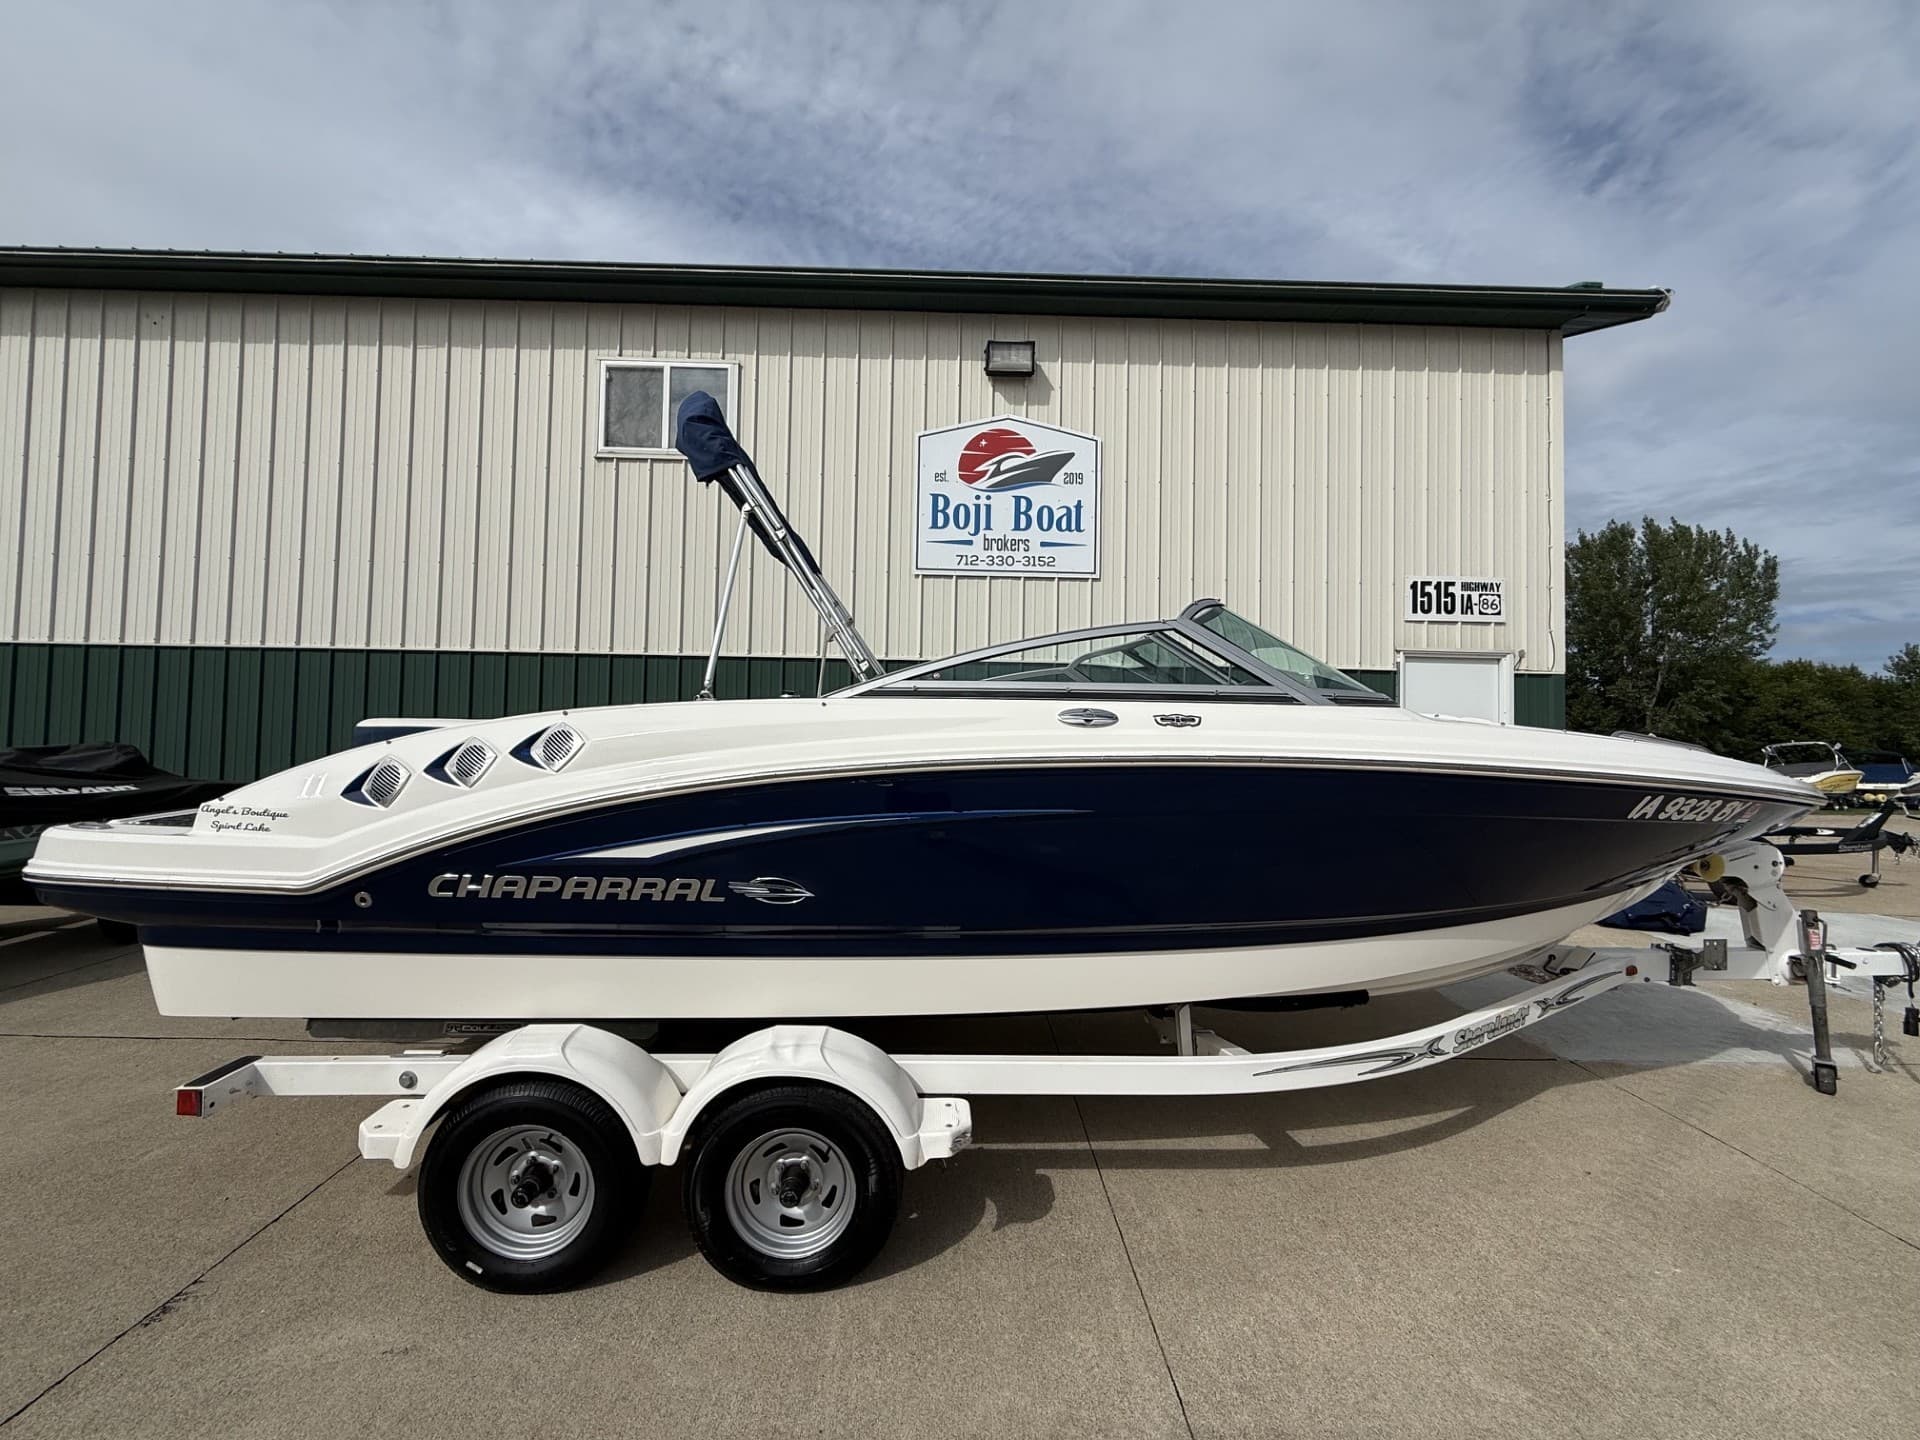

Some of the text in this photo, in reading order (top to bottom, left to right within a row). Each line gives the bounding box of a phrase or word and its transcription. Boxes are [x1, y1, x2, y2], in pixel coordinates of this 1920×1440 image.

[934, 470, 1084, 485] est. 2019
[928, 492, 1086, 536] Boji Boat
[983, 534, 1030, 552] brokers
[956, 554, 1056, 567] 712-330-3152
[1460, 581, 1502, 592] HIGHWAY
[1410, 580, 1457, 615] 1515
[201, 804, 290, 820] Angel's Boutique
[1627, 795, 1665, 820] IA
[1658, 797, 1717, 821] 9328
[210, 820, 272, 832] Spirit Lake
[427, 873, 726, 902] CHAPARRAL
